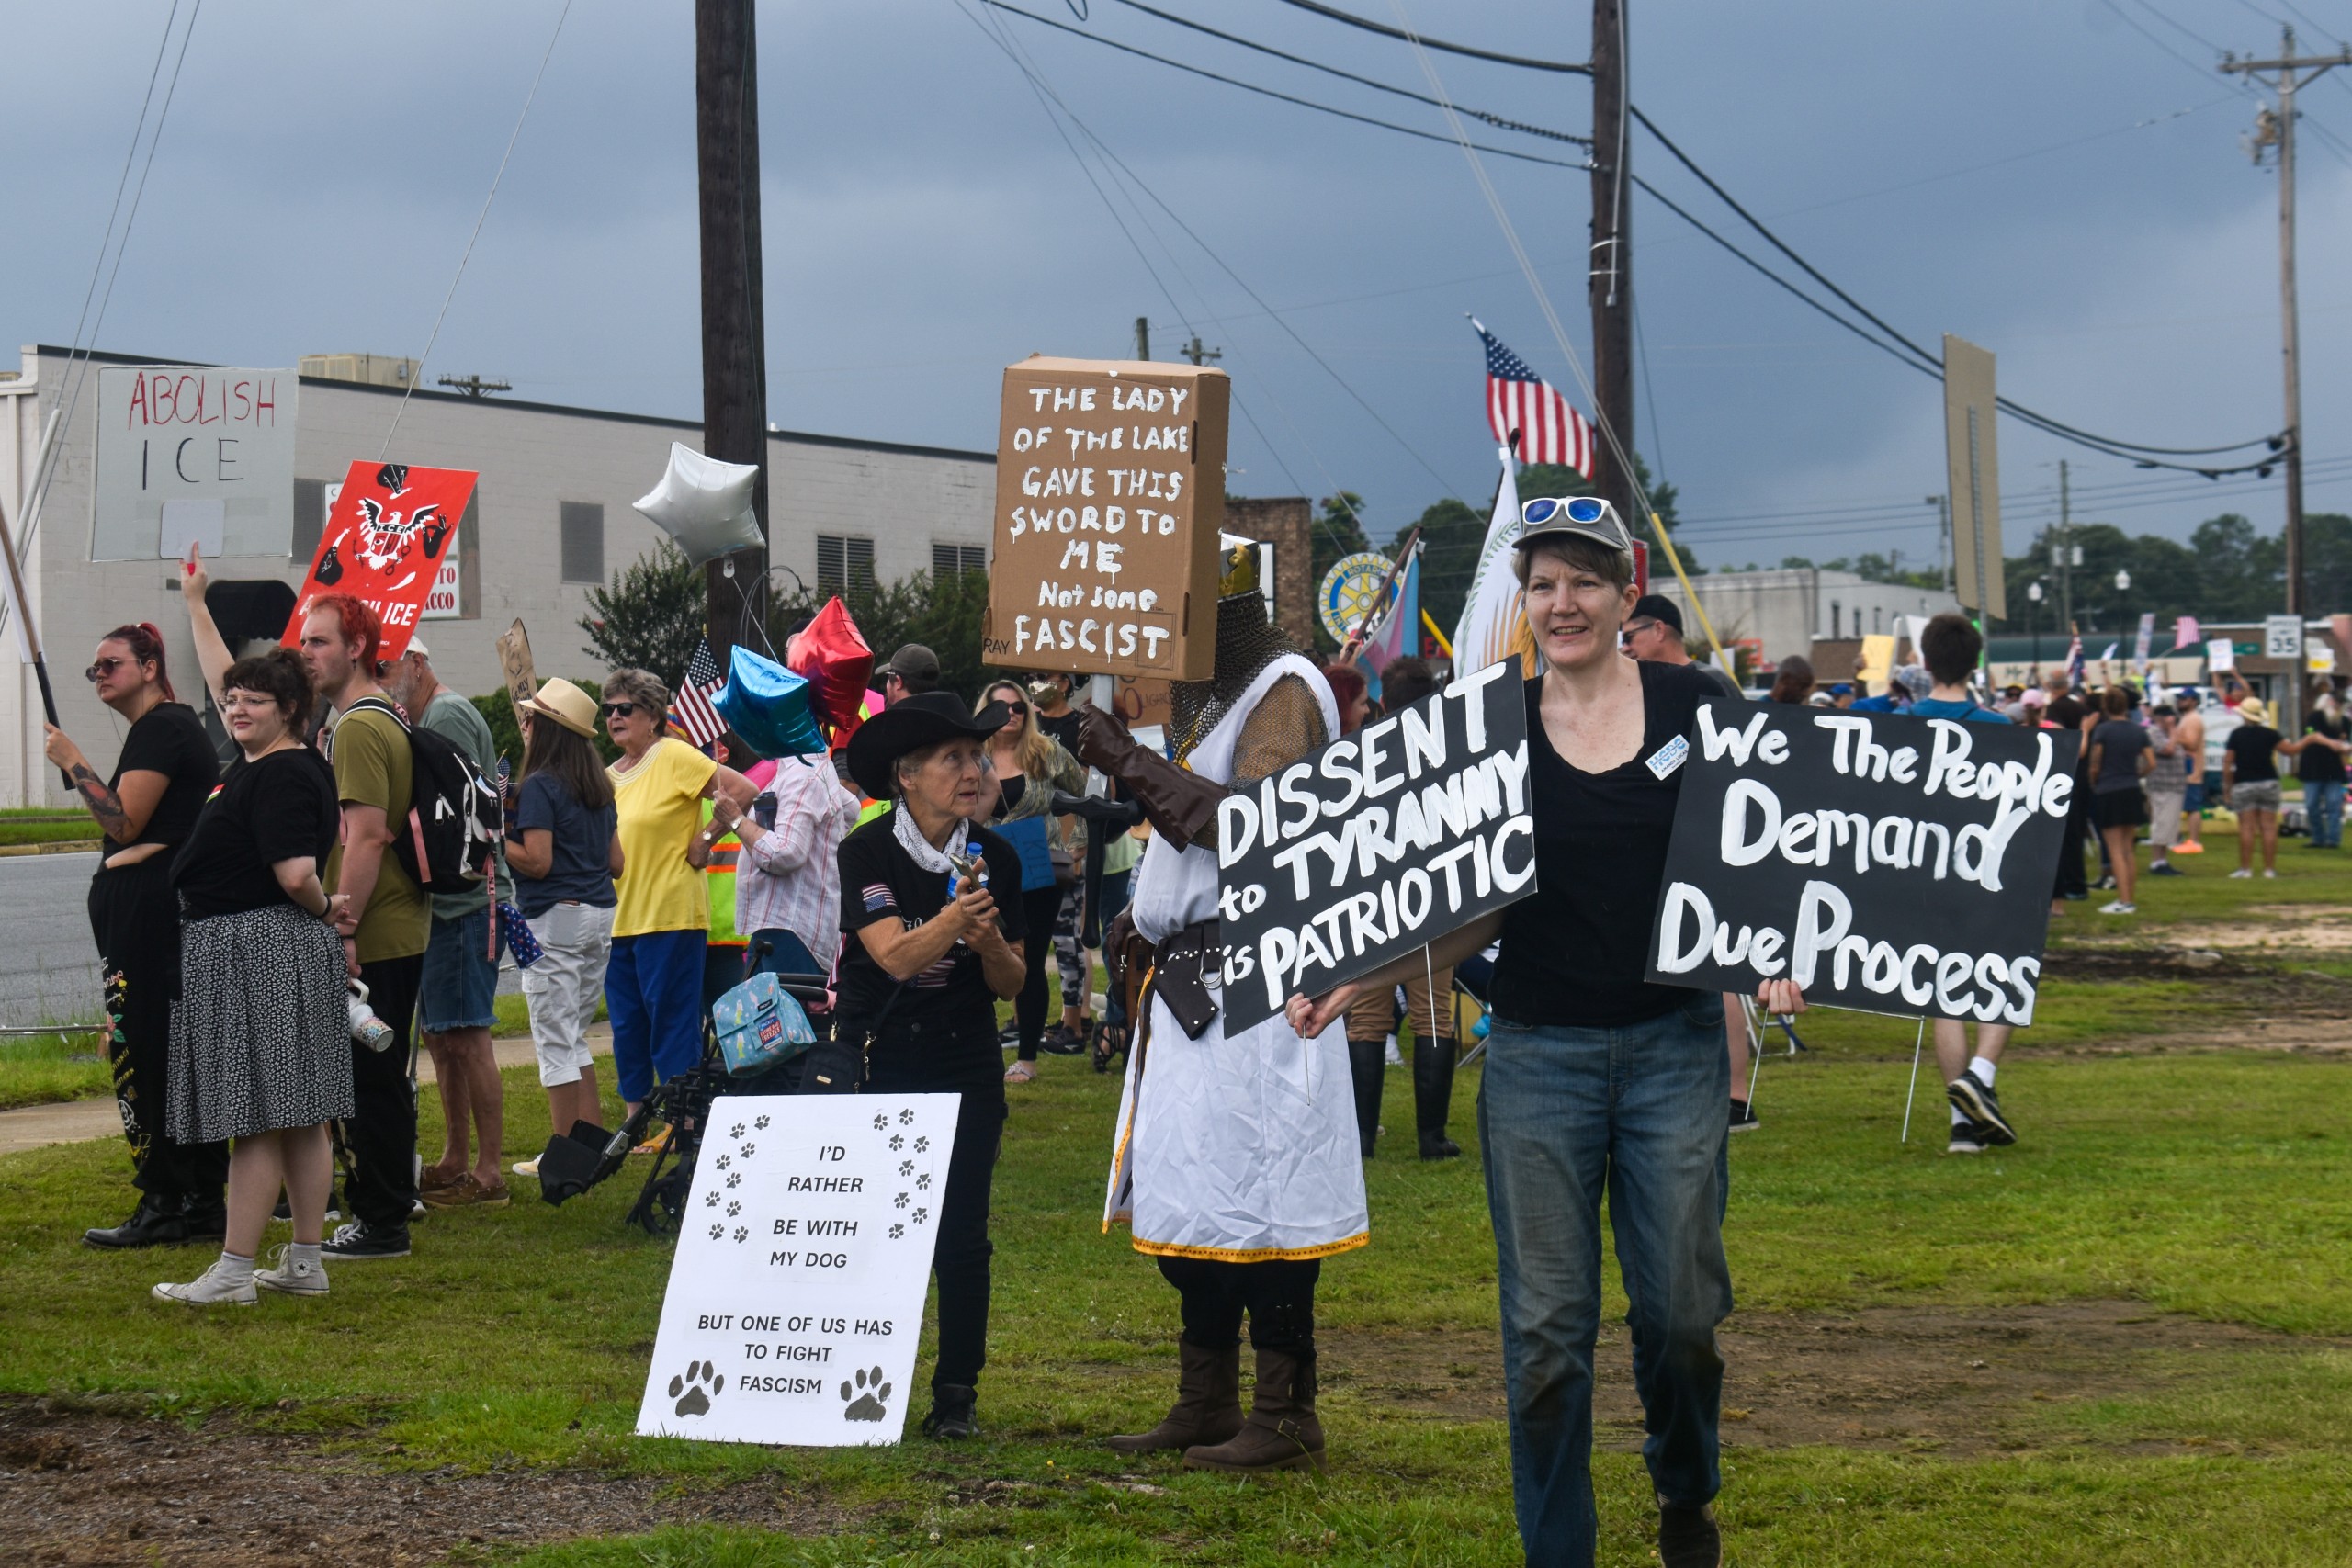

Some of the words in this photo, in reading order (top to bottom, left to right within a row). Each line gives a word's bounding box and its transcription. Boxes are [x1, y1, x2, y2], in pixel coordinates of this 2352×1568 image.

[129, 371, 276, 430] ABOLISH
[1029, 387, 1097, 412] THE
[1113, 386, 1188, 415] LADY
[1013, 426, 1053, 452] OF
[1065, 426, 1124, 461] THE
[1132, 425, 1189, 452] LAKE
[142, 437, 244, 491] ICE
[1022, 466, 1095, 498] GAVE
[1107, 468, 1183, 502] THIS
[379, 525, 403, 533] ICE
[1010, 506, 1126, 544] SWORD
[1060, 538, 1125, 585] ME
[1038, 581, 1085, 608] Not
[382, 602, 417, 626] ICE
[983, 637, 1010, 655] RAY
[1015, 615, 1170, 663] FASCIST
[2271, 637, 2298, 653] 35
[1218, 661, 1507, 869] DISSENT
[1649, 738, 1686, 770] HCDC
[1696, 703, 1791, 767] We
[1814, 715, 1919, 783] The
[1924, 718, 2074, 820] People
[1218, 884, 1266, 921] to
[1273, 739, 1529, 901] TYRANNY
[1721, 778, 2033, 892] Demand
[1223, 944, 1255, 985] is
[1260, 815, 1536, 1010] PATRIOTIC
[1657, 882, 1786, 976] Due
[1791, 880, 2041, 1027] Process
[762, 1028, 781, 1043] FREEZES
[819, 1145, 846, 1162] I'D
[787, 1176, 864, 1193] RATHER
[772, 1219, 797, 1235] BE
[807, 1220, 859, 1236] WITH
[770, 1251, 797, 1266] MY
[805, 1252, 847, 1269] DOG
[697, 1314, 734, 1330] BUT
[741, 1315, 781, 1331] ONE
[787, 1316, 813, 1332] OF
[820, 1317, 846, 1334] US
[854, 1319, 893, 1336] HAS
[744, 1344, 767, 1359] TO
[776, 1345, 832, 1362] FIGHT
[739, 1375, 822, 1394] FASCISM
